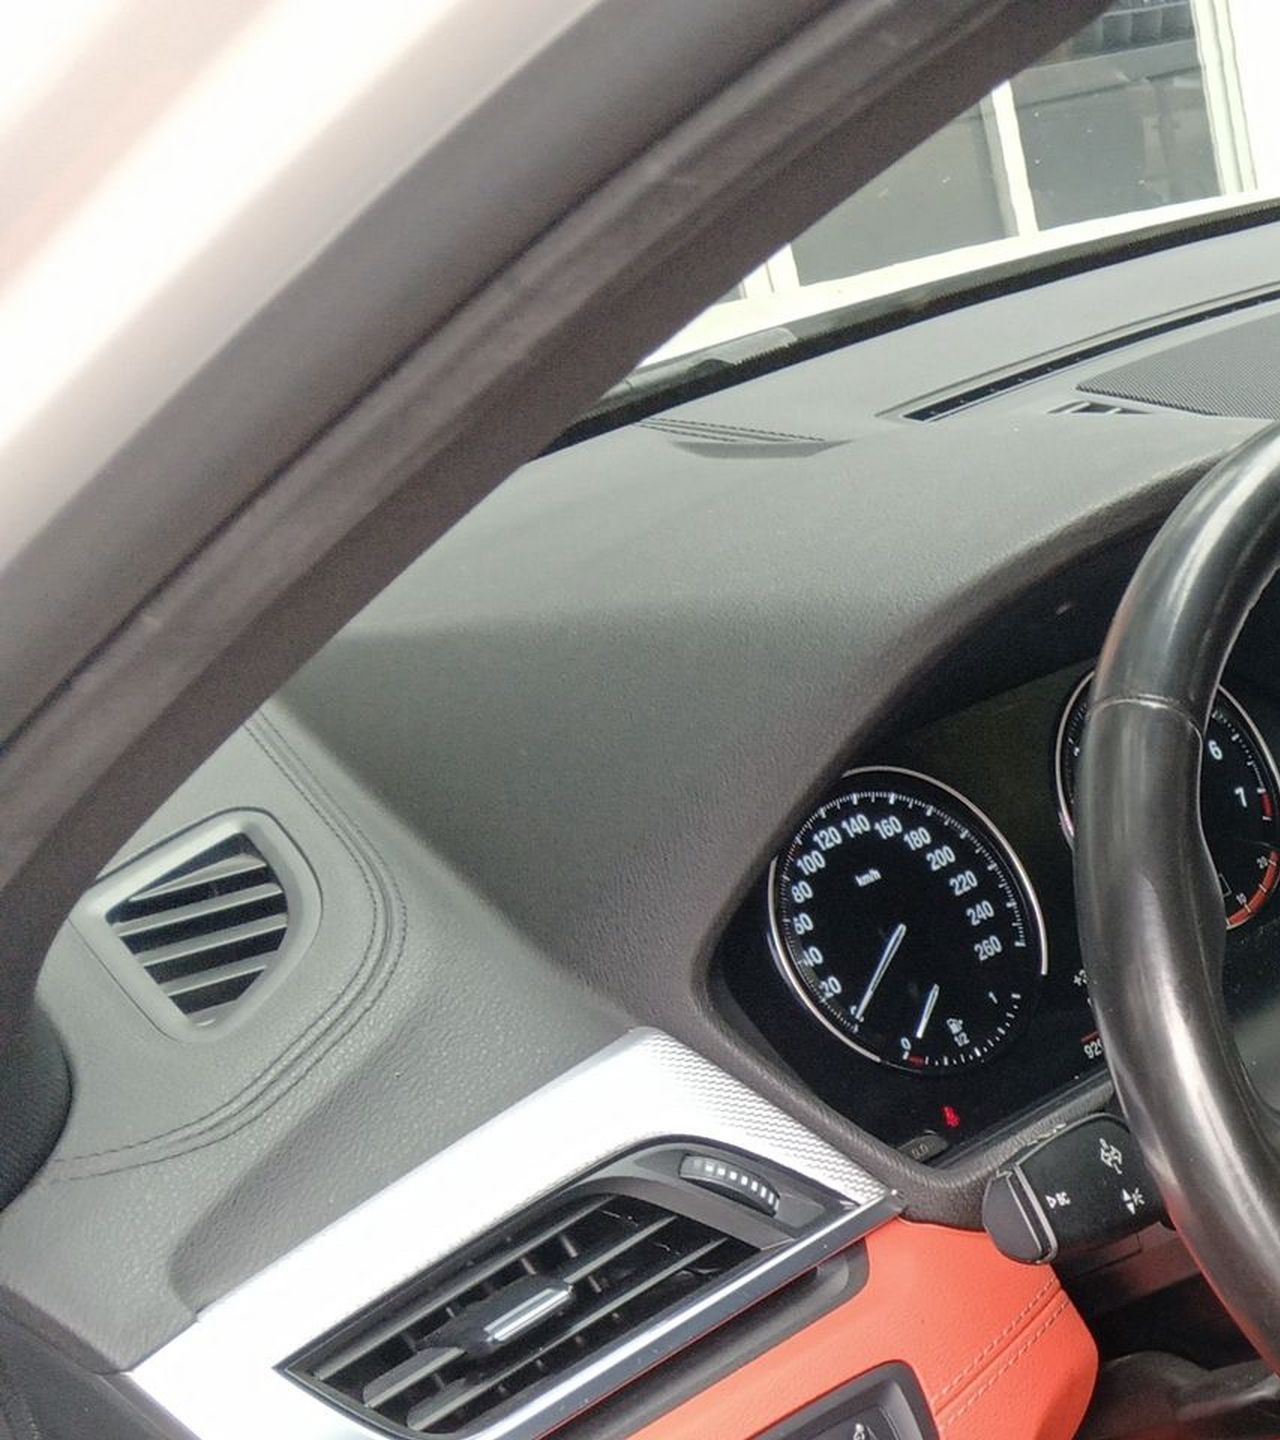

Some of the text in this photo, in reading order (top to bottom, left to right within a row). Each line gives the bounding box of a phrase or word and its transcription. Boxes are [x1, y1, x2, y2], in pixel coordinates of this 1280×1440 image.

[1208, 739, 1224, 761] 6
[841, 813, 870, 838] 140
[874, 815, 902, 839] 160
[813, 826, 842, 850] 120
[903, 826, 931, 850] 180
[796, 850, 826, 876] 100
[926, 845, 956, 871] 200
[855, 868, 882, 887] km/h
[950, 870, 978, 896] 220
[791, 880, 813, 903] 80
[792, 912, 814, 935] 60
[966, 900, 995, 926] 240
[974, 935, 1002, 961] 260
[819, 975, 842, 998] 20
[901, 1037, 911, 1050] 0
